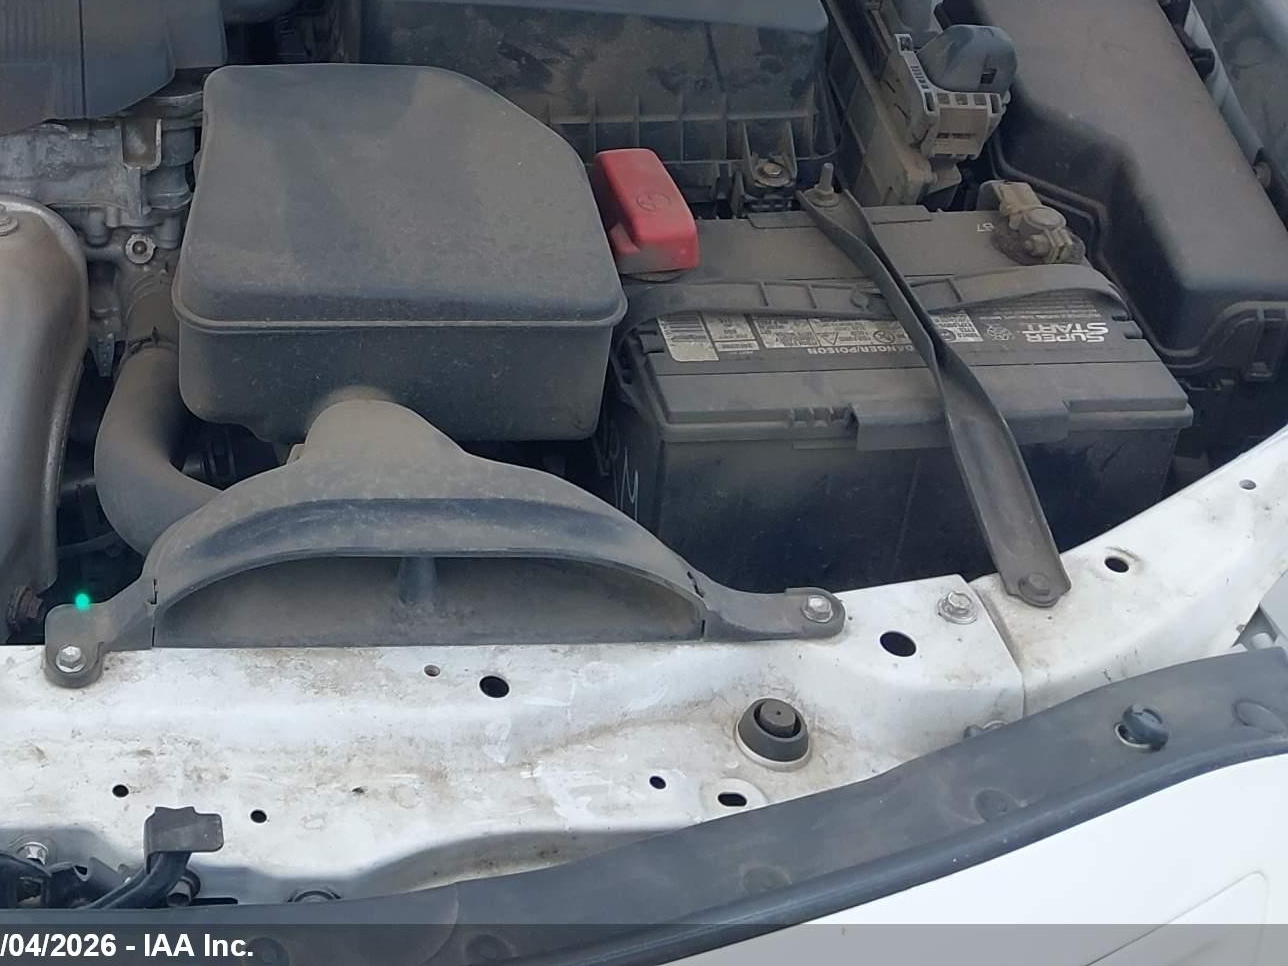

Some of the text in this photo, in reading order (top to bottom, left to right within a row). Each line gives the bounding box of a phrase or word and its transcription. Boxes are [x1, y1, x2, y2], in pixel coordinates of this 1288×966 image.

[1022, 322, 1109, 334] START
[1024, 333, 1105, 343] SUPER
[807, 344, 914, 355] DANGER/POISON
